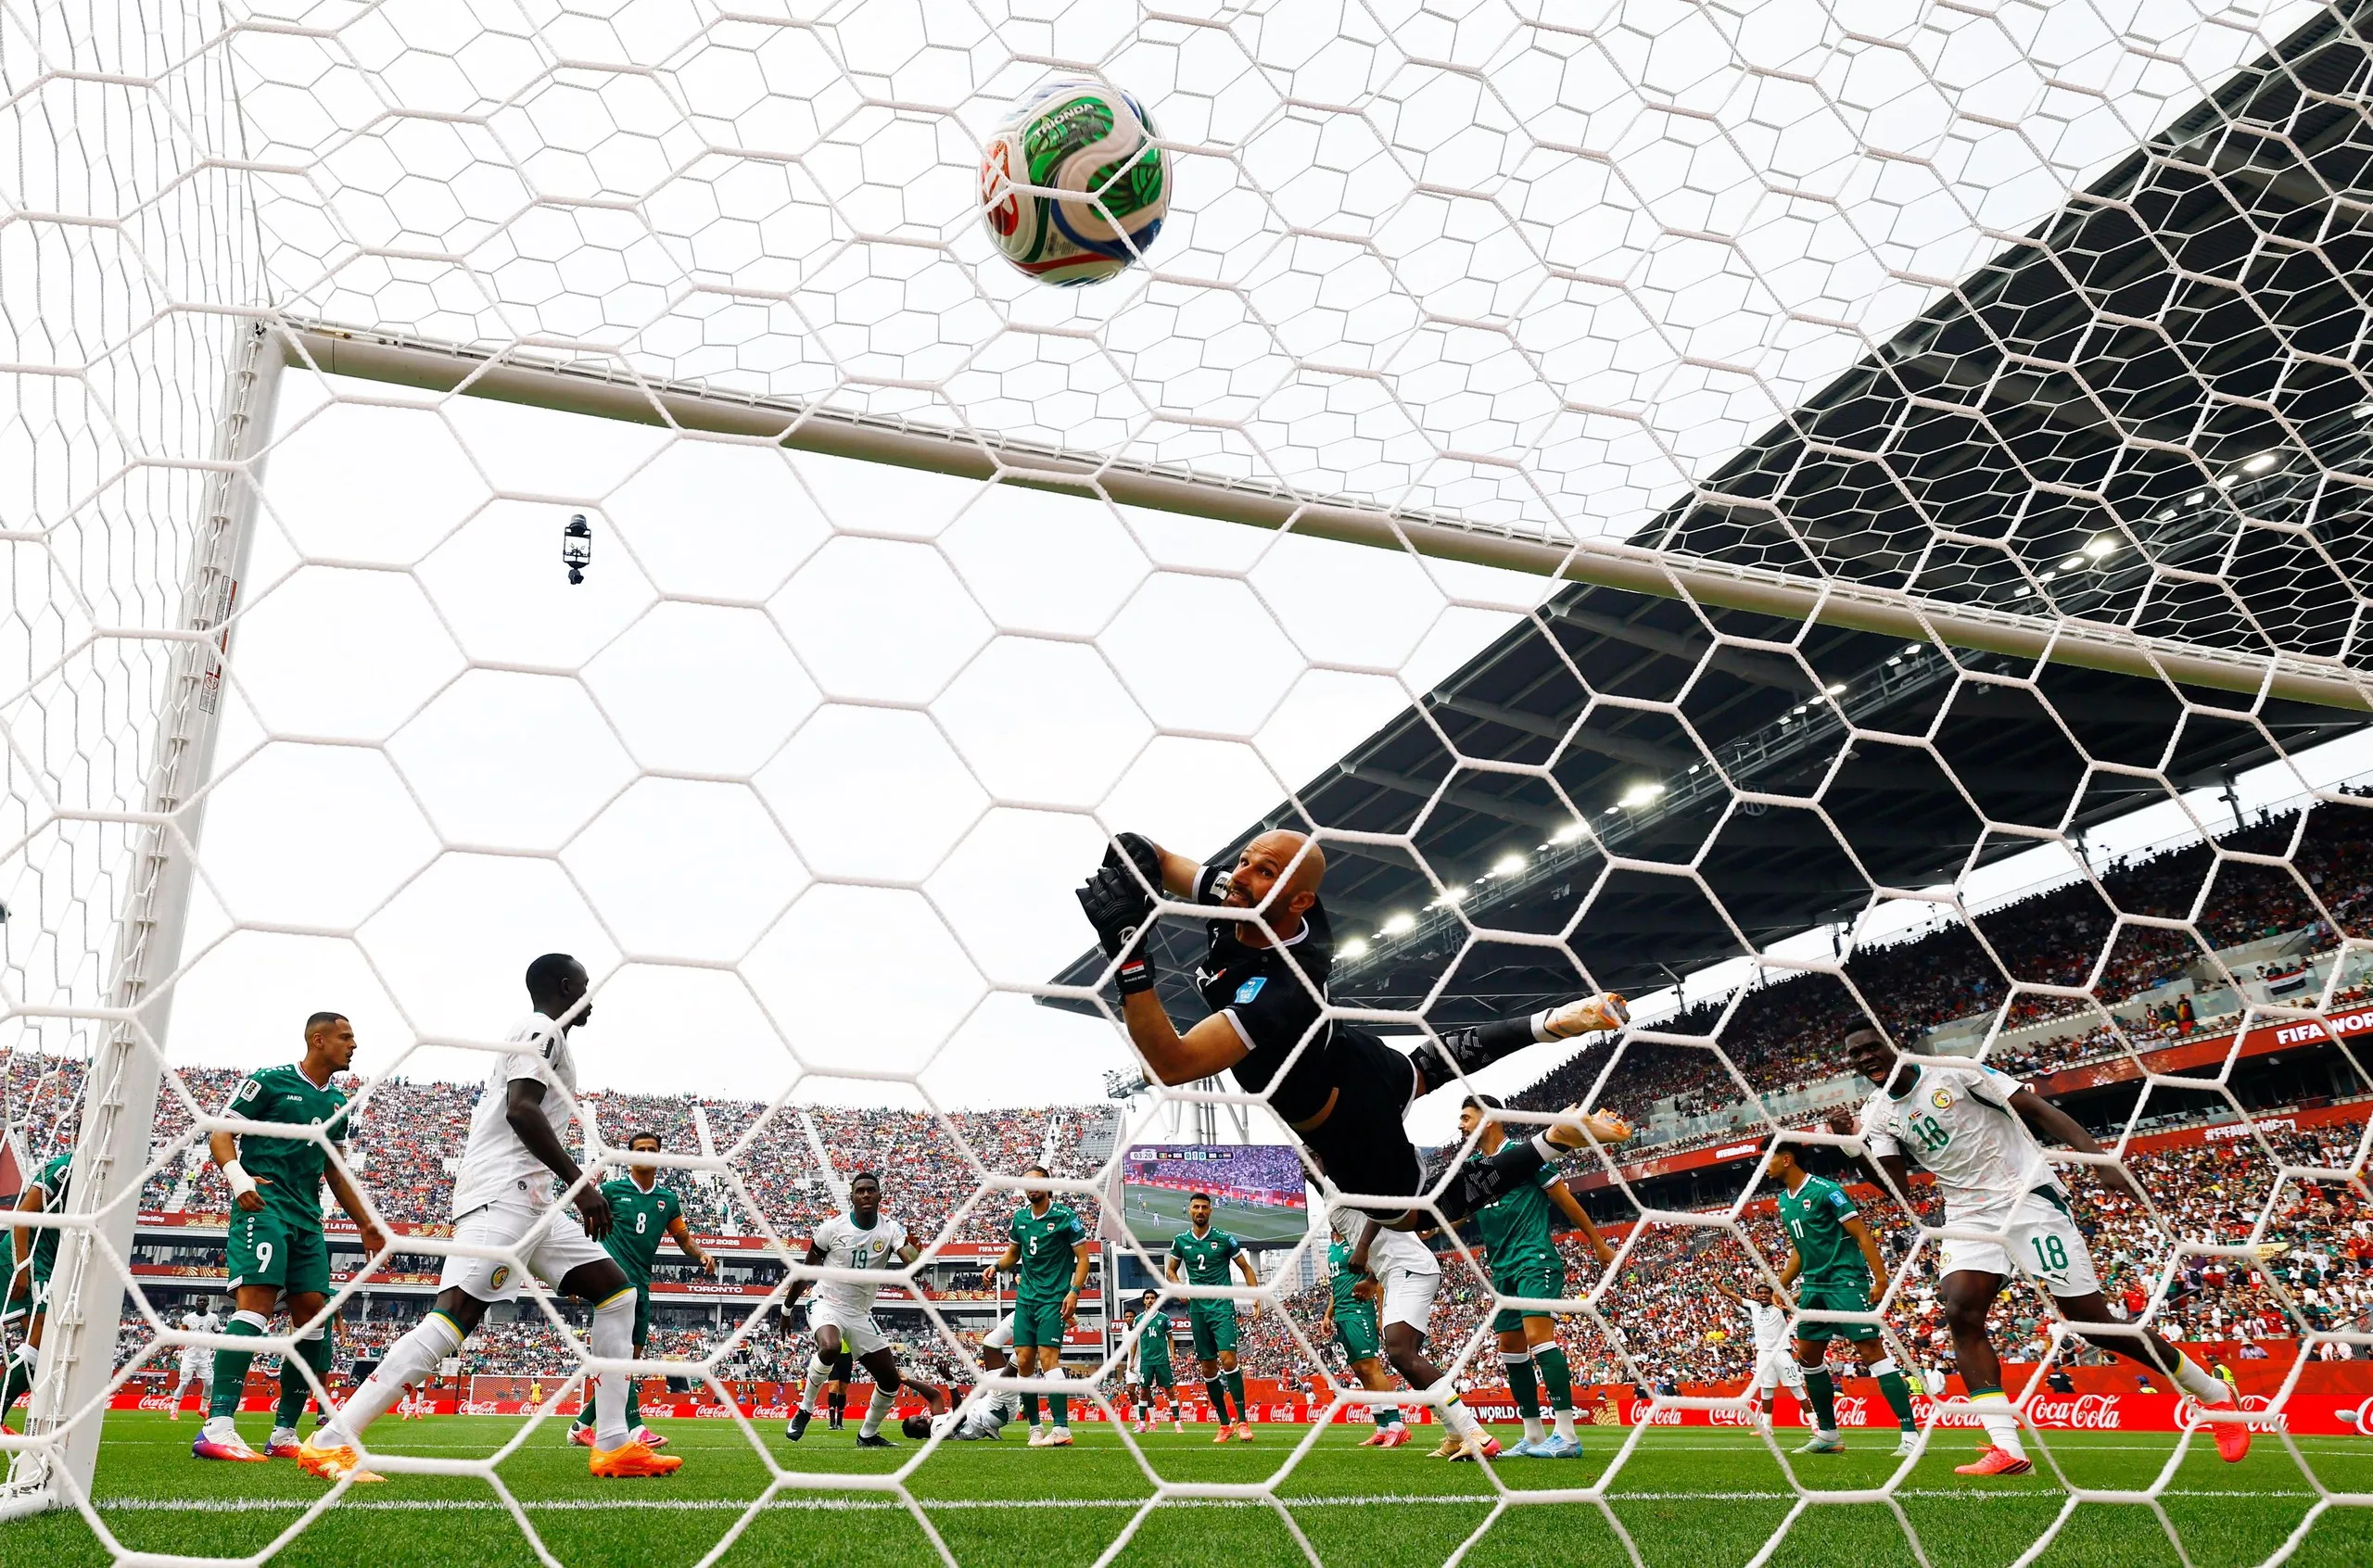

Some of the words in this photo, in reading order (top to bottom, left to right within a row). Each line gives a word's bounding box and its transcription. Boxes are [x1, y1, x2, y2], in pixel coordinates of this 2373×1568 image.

[1034, 103, 1097, 138] TRIONDA
[2276, 1023, 2326, 1044] FIFA
[2328, 1012, 2373, 1033] WOR
[286, 1094, 303, 1103] JAKO
[1911, 1115, 1949, 1152] 18
[635, 1212, 647, 1234] 8
[1790, 1218, 1805, 1240] 11
[1029, 1236, 1038, 1255] 5
[2031, 1235, 2069, 1272] 18
[256, 1242, 273, 1273] 9
[851, 1249, 869, 1269] 19
[1197, 1254, 1206, 1271] 2
[687, 1285, 742, 1294] TORONTO
[1148, 1326, 1157, 1337] 14
[1785, 1366, 1796, 1379] 20
[639, 1404, 676, 1417] Coca-Cola
[753, 1406, 788, 1419] Coca-Cola
[1270, 1405, 1295, 1422] Coca-Cola
[1478, 1406, 1515, 1419] WORLD
[2026, 1394, 2121, 1428] Coca-Cola
